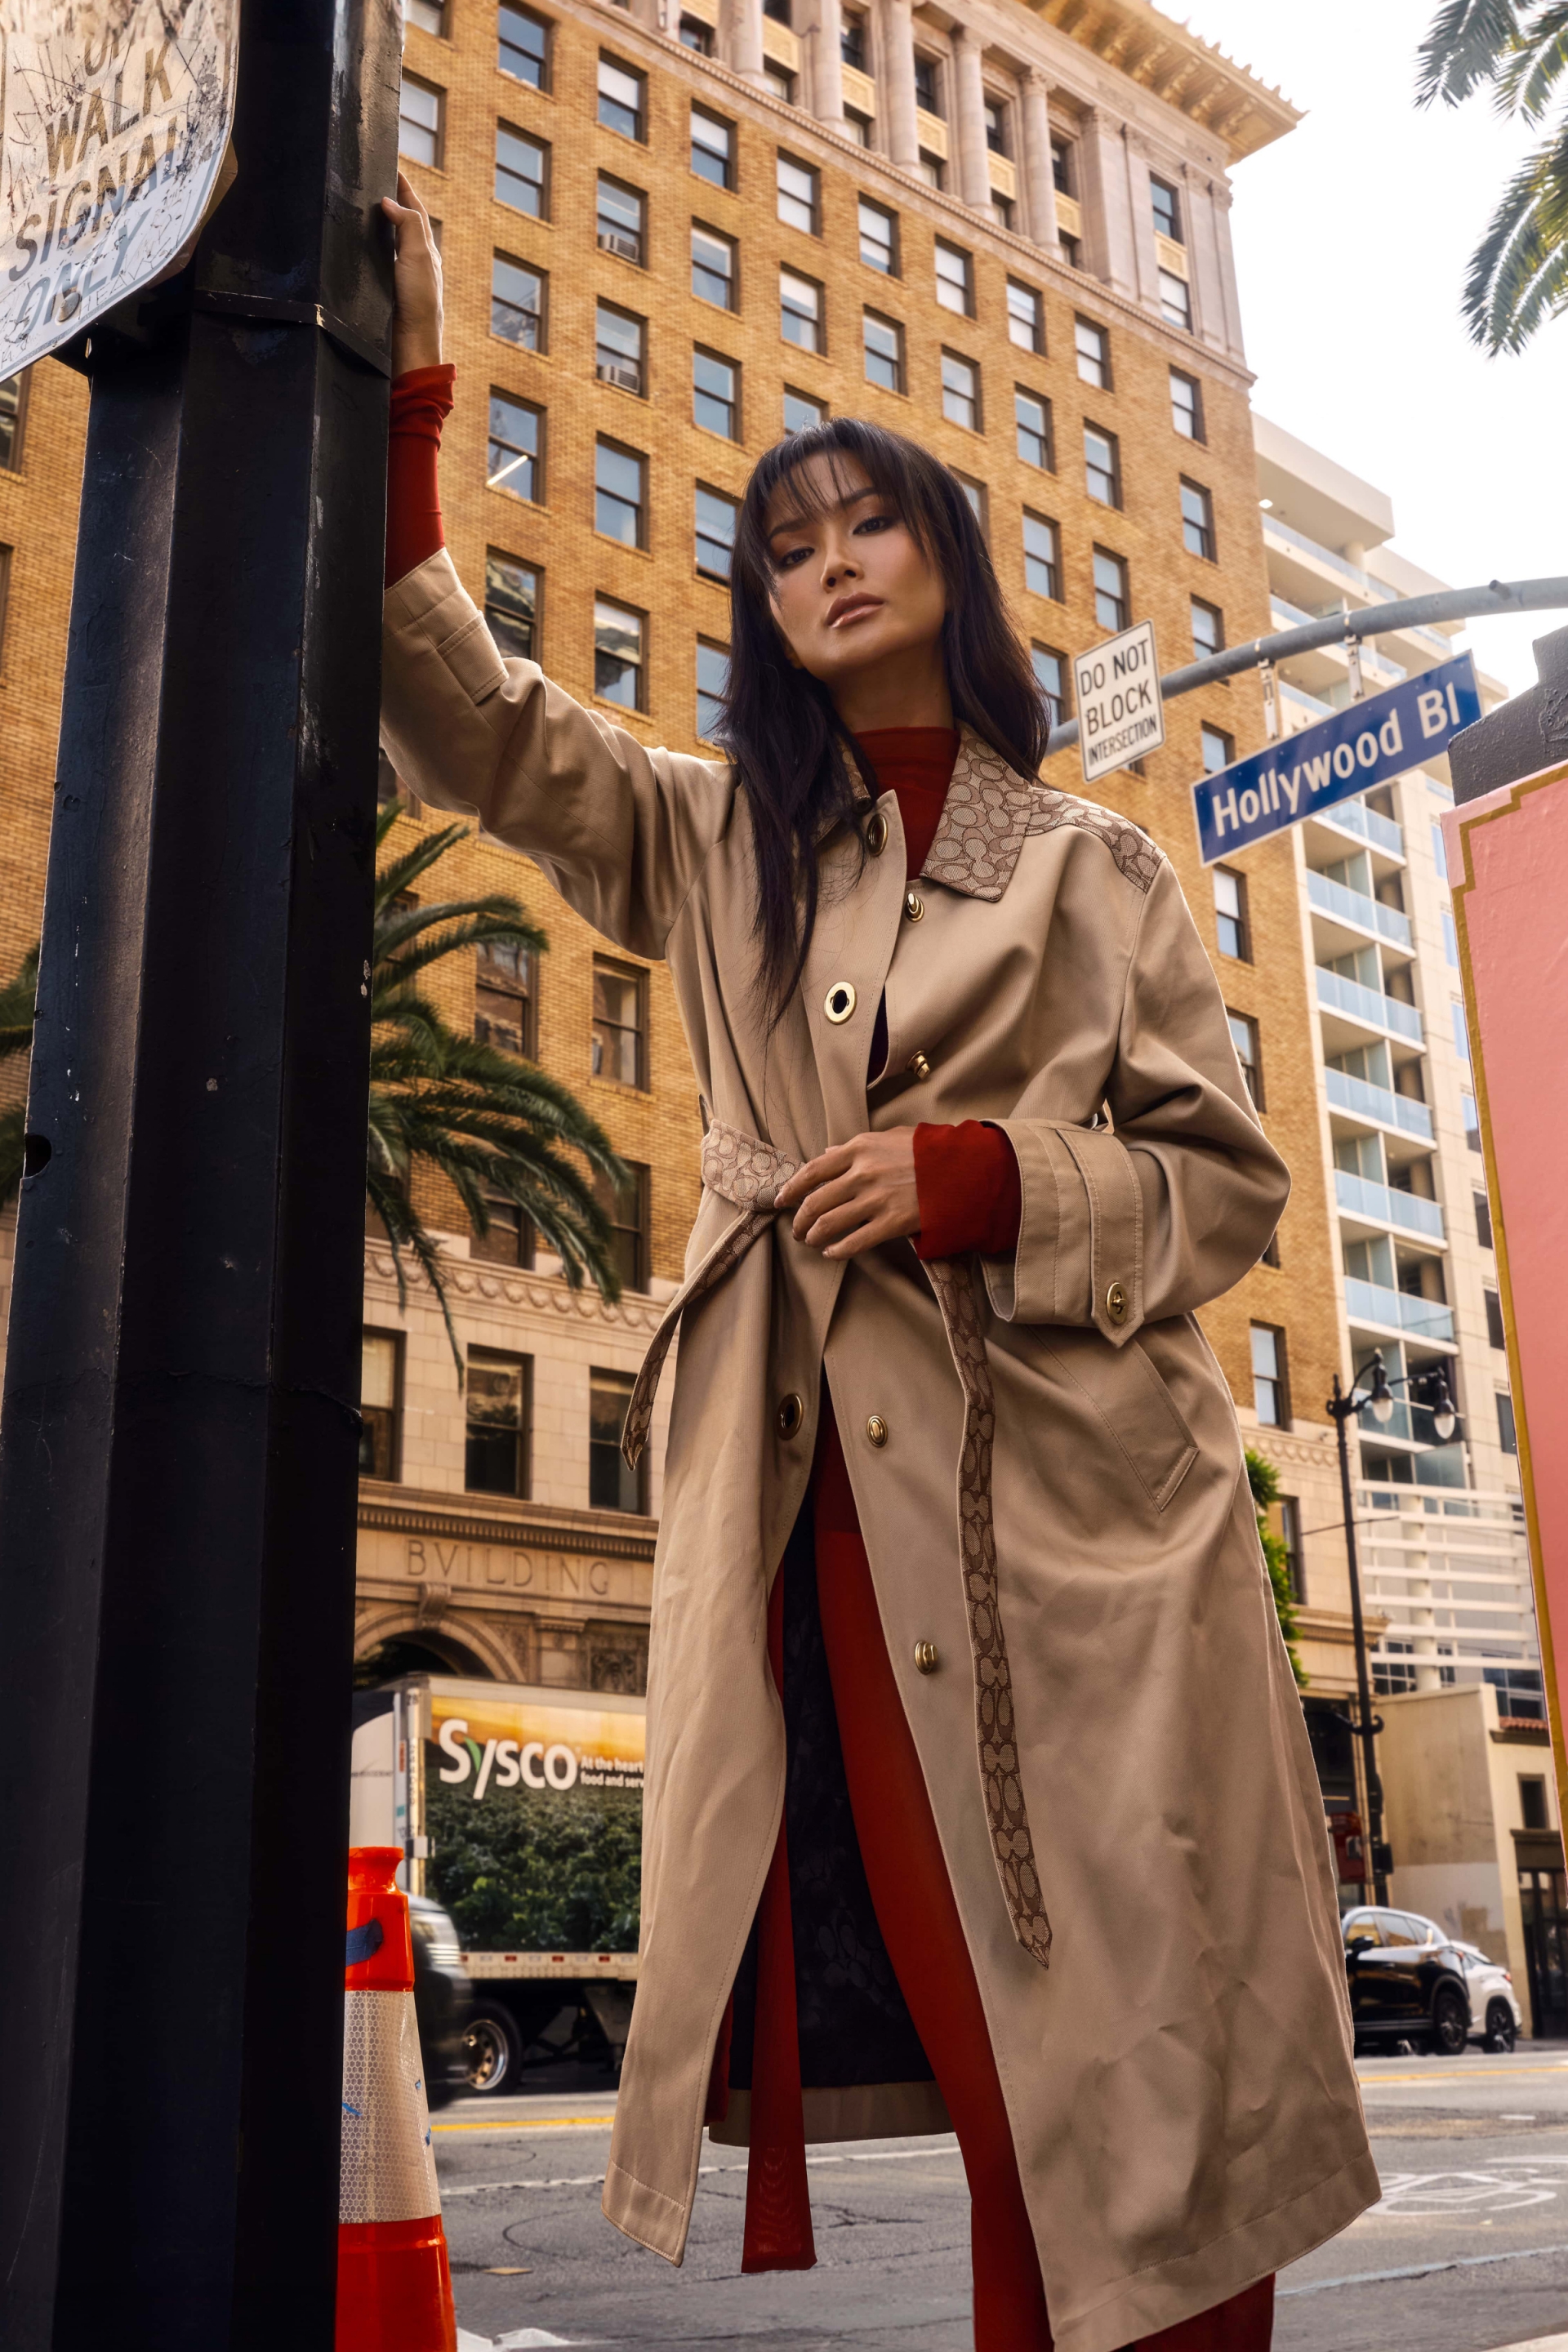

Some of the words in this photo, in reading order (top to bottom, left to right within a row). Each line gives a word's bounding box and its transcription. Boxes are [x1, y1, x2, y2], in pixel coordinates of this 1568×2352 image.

[45, 38, 173, 185] WALK
[15, 207, 153, 344] ONLY
[1080, 662, 1106, 697] DO
[1112, 638, 1149, 680] NOT
[1086, 679, 1152, 737] BLOCK
[1088, 712, 1158, 767] INTERSECTION
[1212, 707, 1404, 838] Hollywood
[1416, 681, 1461, 739] Bl
[407, 1539, 609, 1596] BVILDING
[581, 1755, 594, 1771] At
[595, 1756, 613, 1771] the
[614, 1757, 644, 1774] heart
[581, 1771, 604, 1787] food
[605, 1773, 624, 1788] and
